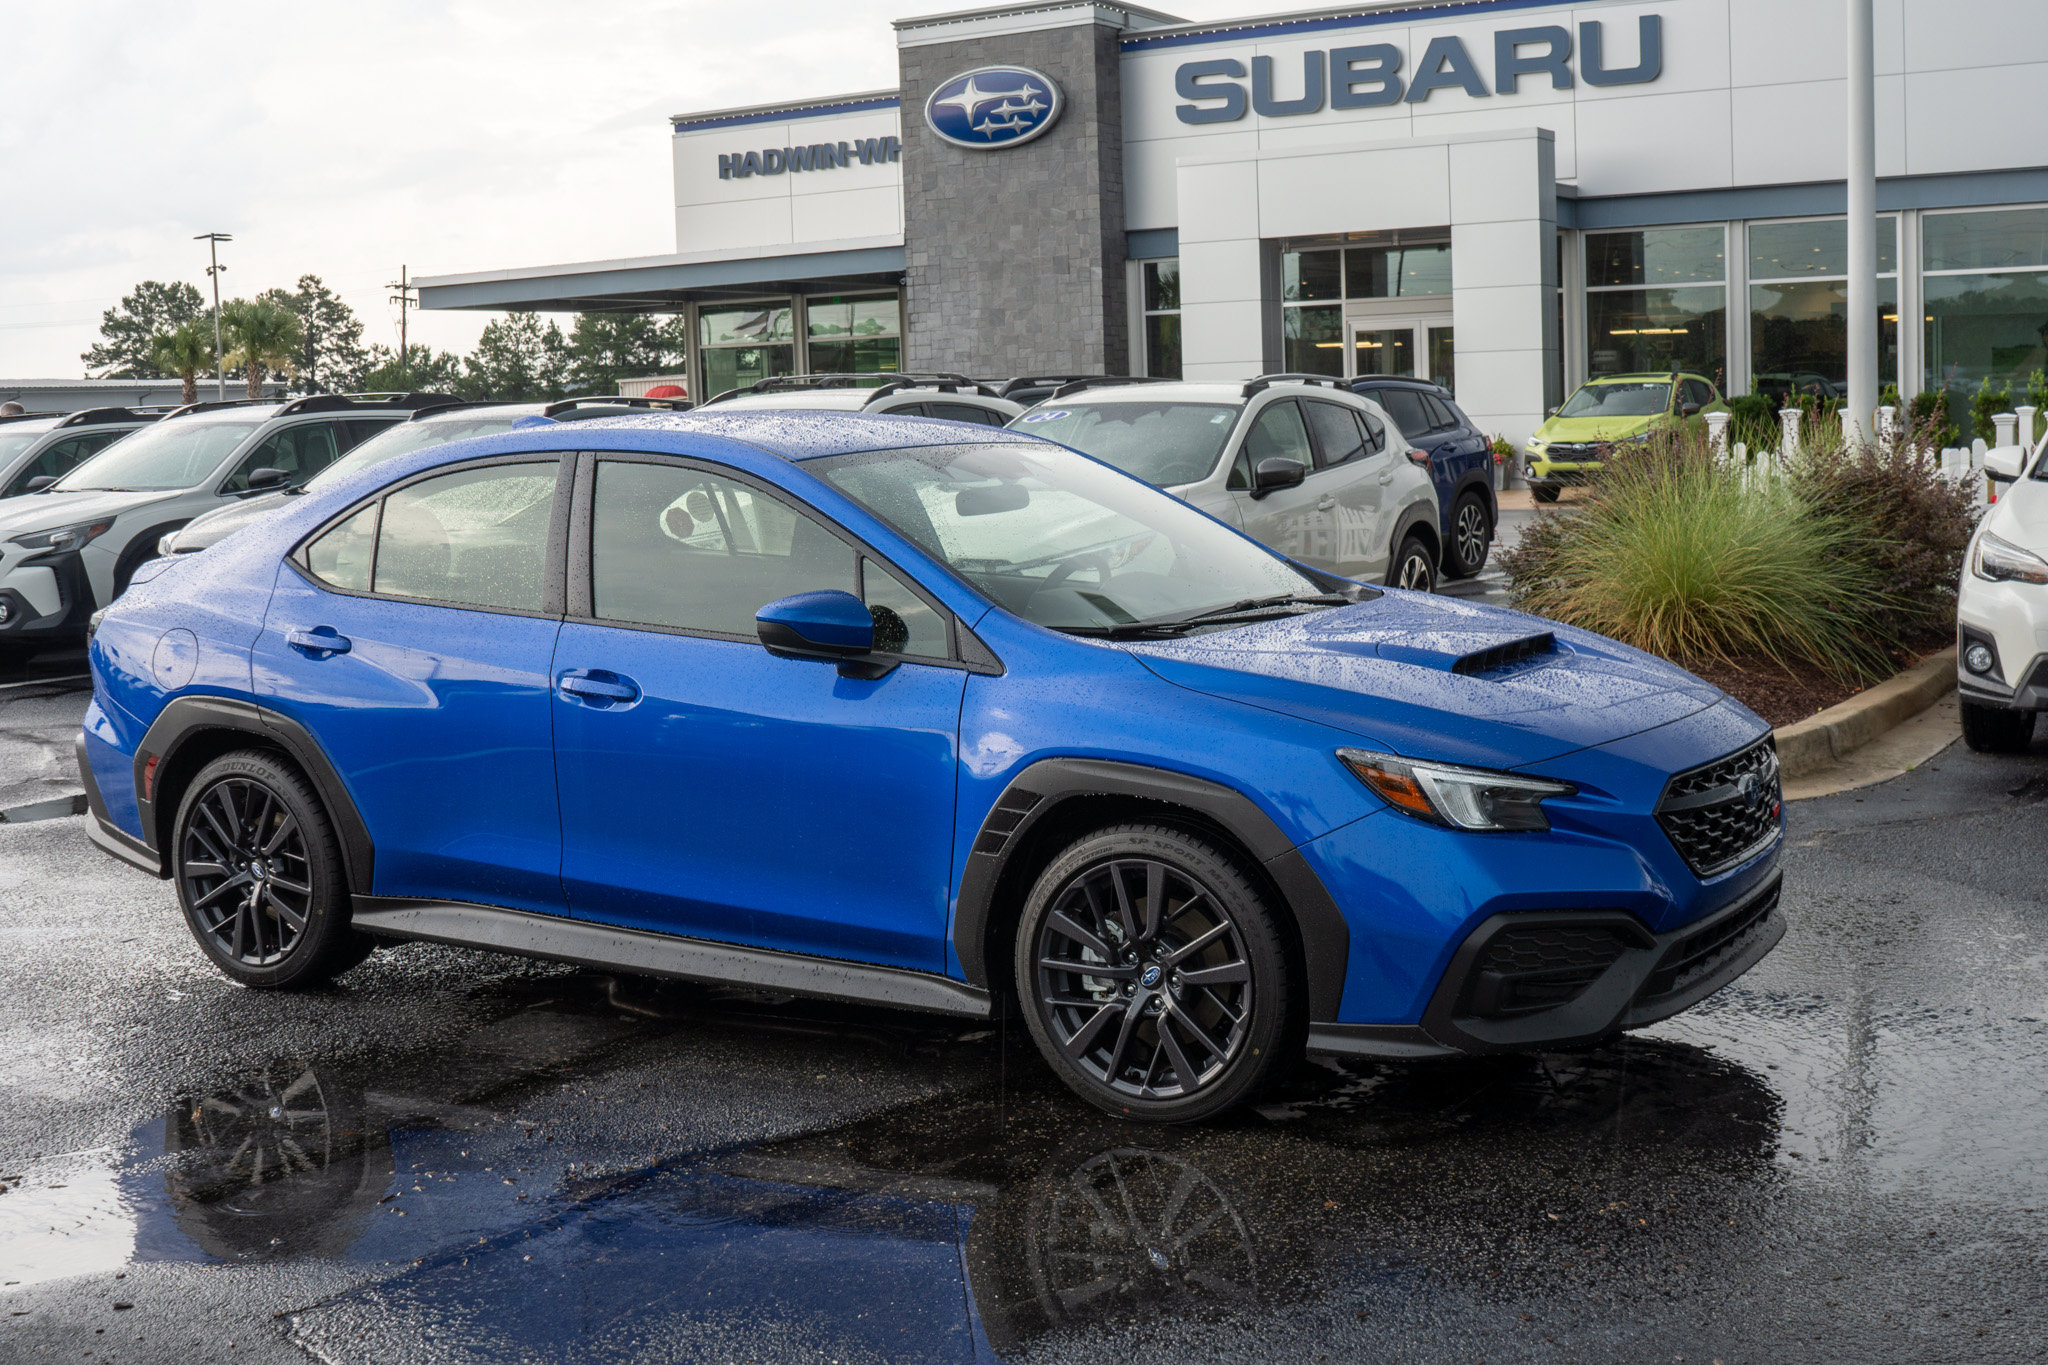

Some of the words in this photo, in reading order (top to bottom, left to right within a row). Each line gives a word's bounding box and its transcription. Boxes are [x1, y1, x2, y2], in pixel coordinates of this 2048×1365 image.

[1175, 14, 1661, 125] SUBARU
[220, 761, 277, 780] DUNLOP
[1154, 840, 1206, 866] SPORT
